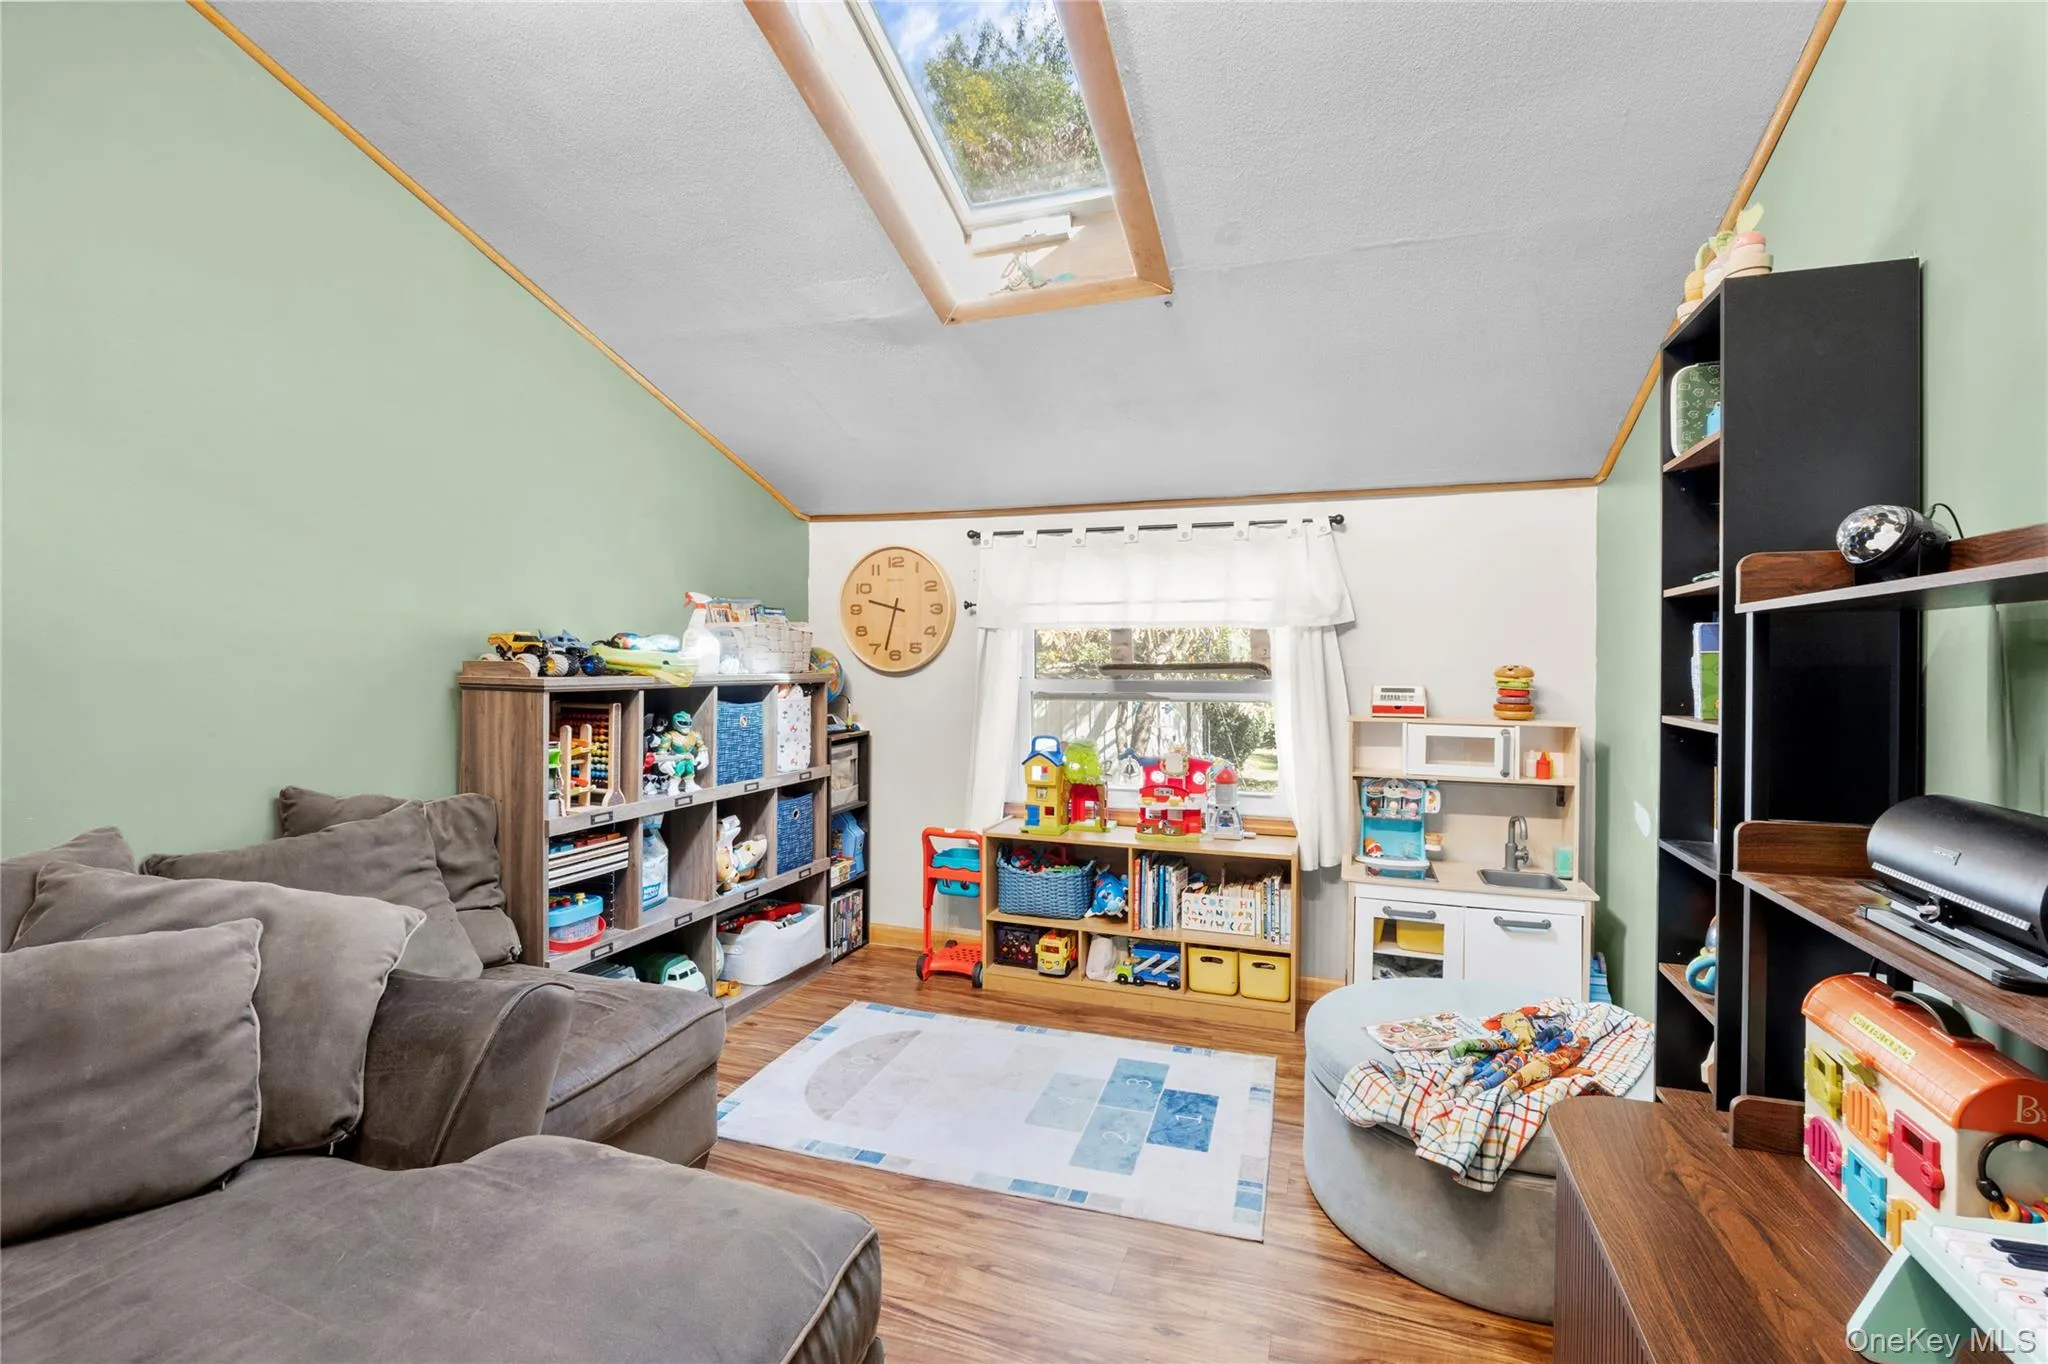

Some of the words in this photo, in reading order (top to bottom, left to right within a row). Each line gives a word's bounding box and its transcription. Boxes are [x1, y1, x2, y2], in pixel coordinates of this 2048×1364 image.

[888, 556, 905, 568] 12
[871, 564, 881, 576] 11
[855, 583, 872, 594] 10
[924, 580, 938, 592] 2
[850, 604, 862, 615] 9
[930, 603, 944, 615] 3
[855, 626, 868, 637] 8
[924, 626, 937, 638] 4
[869, 643, 881, 655] 7
[909, 642, 922, 654] 5
[889, 650, 902, 661] 6
[1126, 1078, 1152, 1089] 3
[1175, 1114, 1202, 1124] 1
[1102, 1131, 1131, 1144] 2
